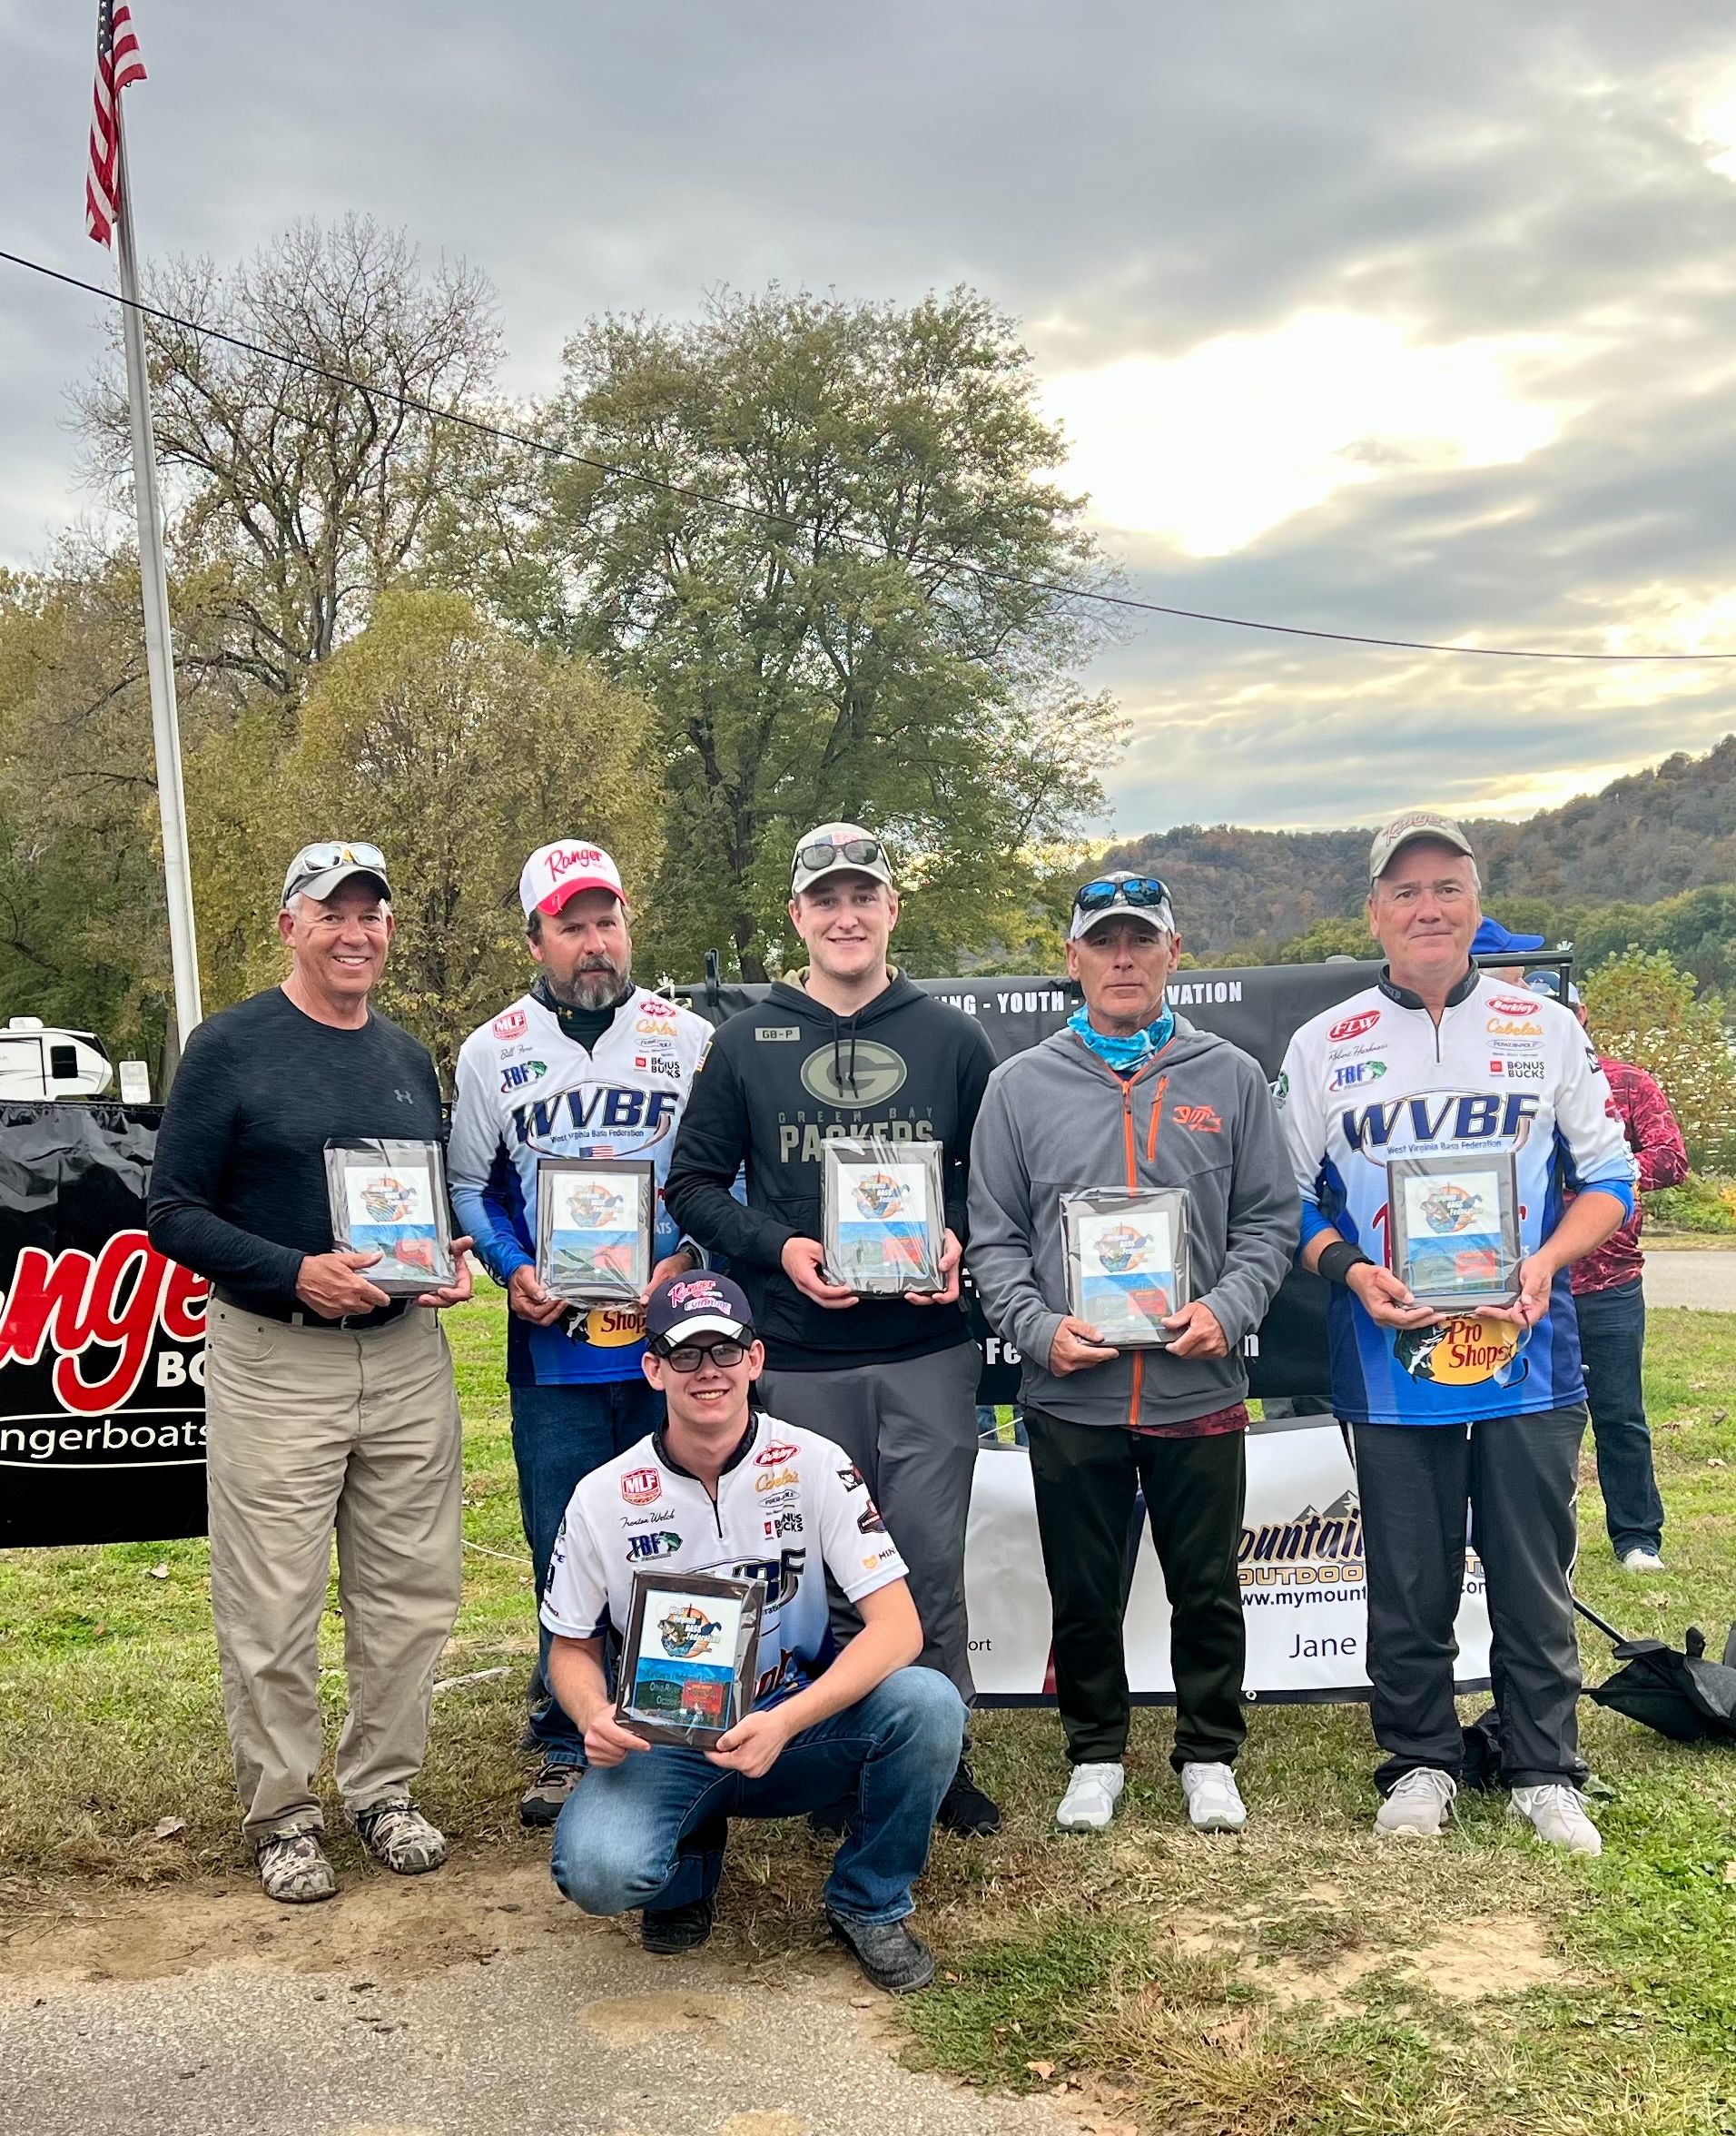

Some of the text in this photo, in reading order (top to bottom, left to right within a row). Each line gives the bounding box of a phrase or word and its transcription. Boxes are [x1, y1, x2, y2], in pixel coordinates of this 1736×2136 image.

[1382, 814, 1444, 846] Ranger
[544, 849, 603, 883] Ranger
[996, 991, 1065, 1014] YOUTH
[1493, 1000, 1535, 1014] Berkley
[496, 1014, 524, 1032] MLF
[762, 1030, 793, 1039] GB-P
[1332, 1014, 1380, 1036] FLW
[500, 1063, 530, 1089] TBF
[1335, 1062, 1365, 1087] TBF
[1507, 1061, 1545, 1071] BONUS
[1508, 1070, 1545, 1080] BUCKS
[511, 1087, 680, 1145] WVBF
[778, 1106, 932, 1124] GREEN BAY
[1342, 1092, 1541, 1152] WVBF
[1386, 1140, 1502, 1156] West Virginia Bass Federation
[1447, 1320, 1482, 1345] Pro
[1449, 1344, 1511, 1370] Shops
[625, 1474, 656, 1493] MLF
[627, 1533, 661, 1558] TBF
[1288, 1633, 1357, 1659] Jane
